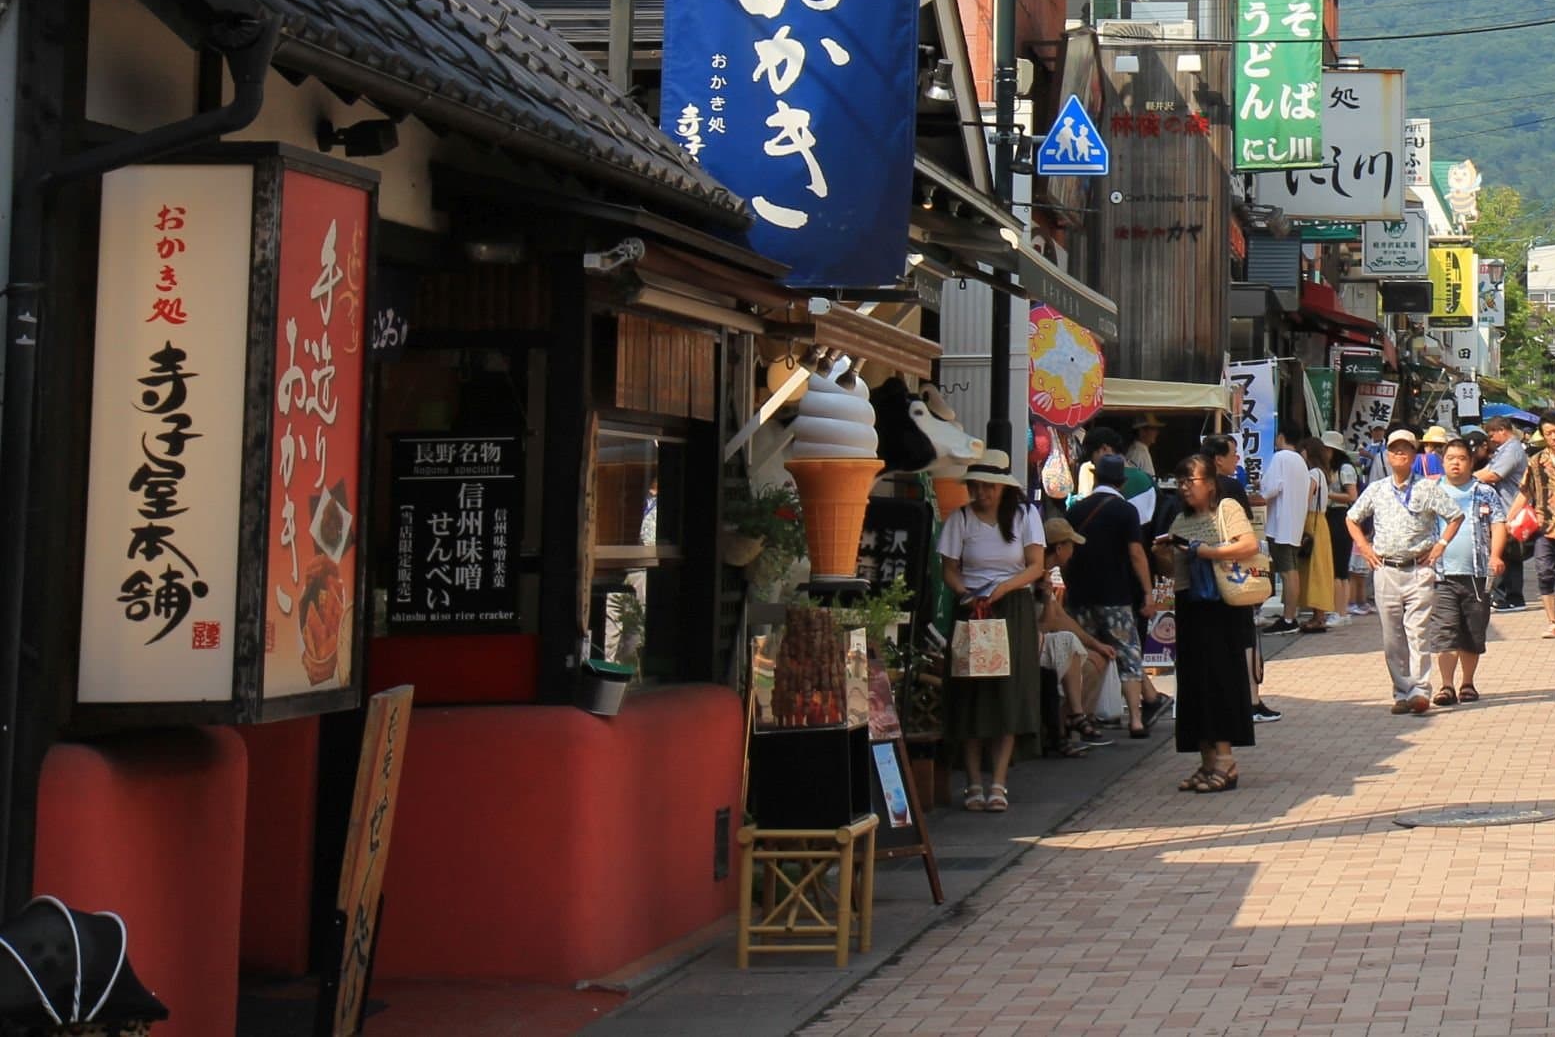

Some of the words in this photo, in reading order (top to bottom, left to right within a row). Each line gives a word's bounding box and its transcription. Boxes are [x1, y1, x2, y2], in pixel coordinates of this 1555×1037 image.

[707, 53, 727, 134] おかき処
[1240, 2, 1277, 120] うどん
[1280, 2, 1317, 120] そば
[1242, 137, 1312, 162] にし川
[145, 203, 188, 325] おかき処
[116, 339, 209, 646] 寺子屋本舗
[415, 442, 501, 463] 長野名物
[425, 511, 454, 610] せんべい
[455, 482, 485, 591] 信州味噌
[455, 611, 475, 620] rice
